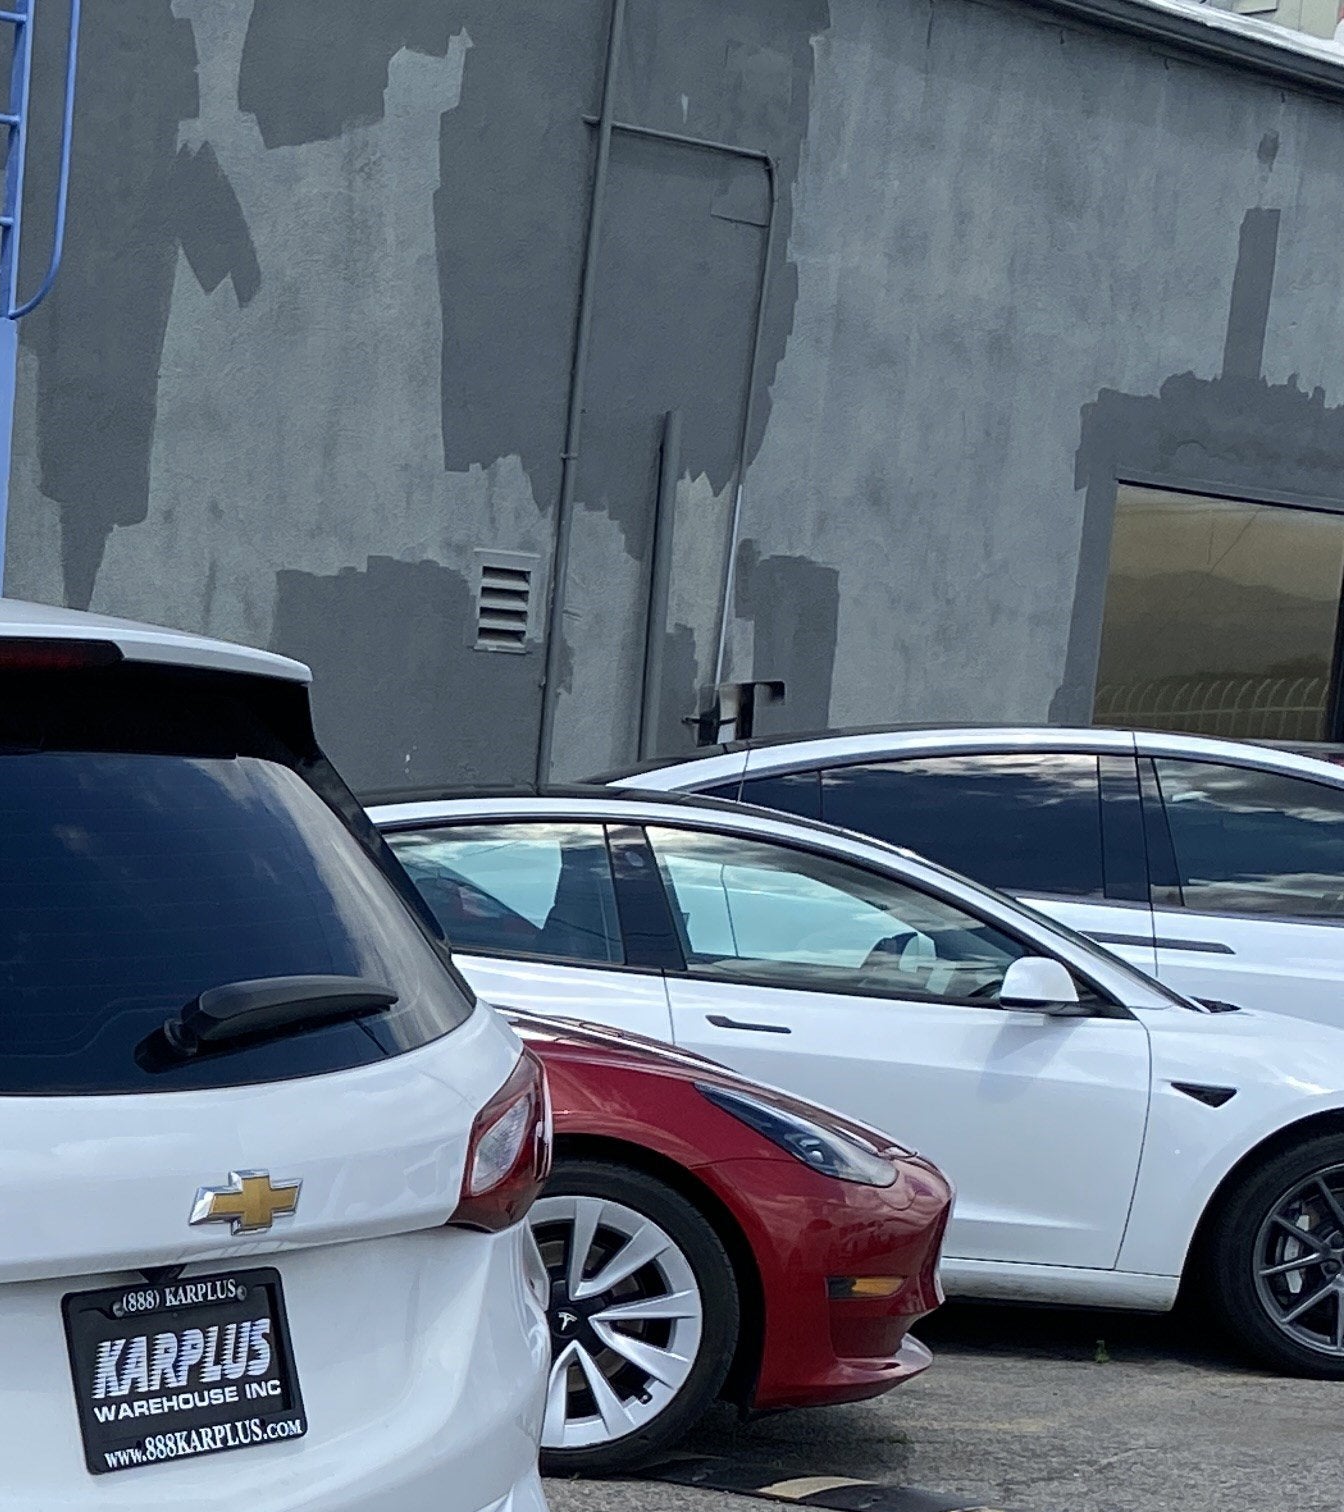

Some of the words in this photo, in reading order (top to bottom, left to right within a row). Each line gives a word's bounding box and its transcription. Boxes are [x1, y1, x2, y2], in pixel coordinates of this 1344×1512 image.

[122, 1289, 161, 1313] (888)
[165, 1278, 237, 1307] KARPLUS
[91, 1318, 271, 1400] KARPLUS
[93, 1386, 239, 1424] WAREHOUSE
[245, 1379, 283, 1399] INC
